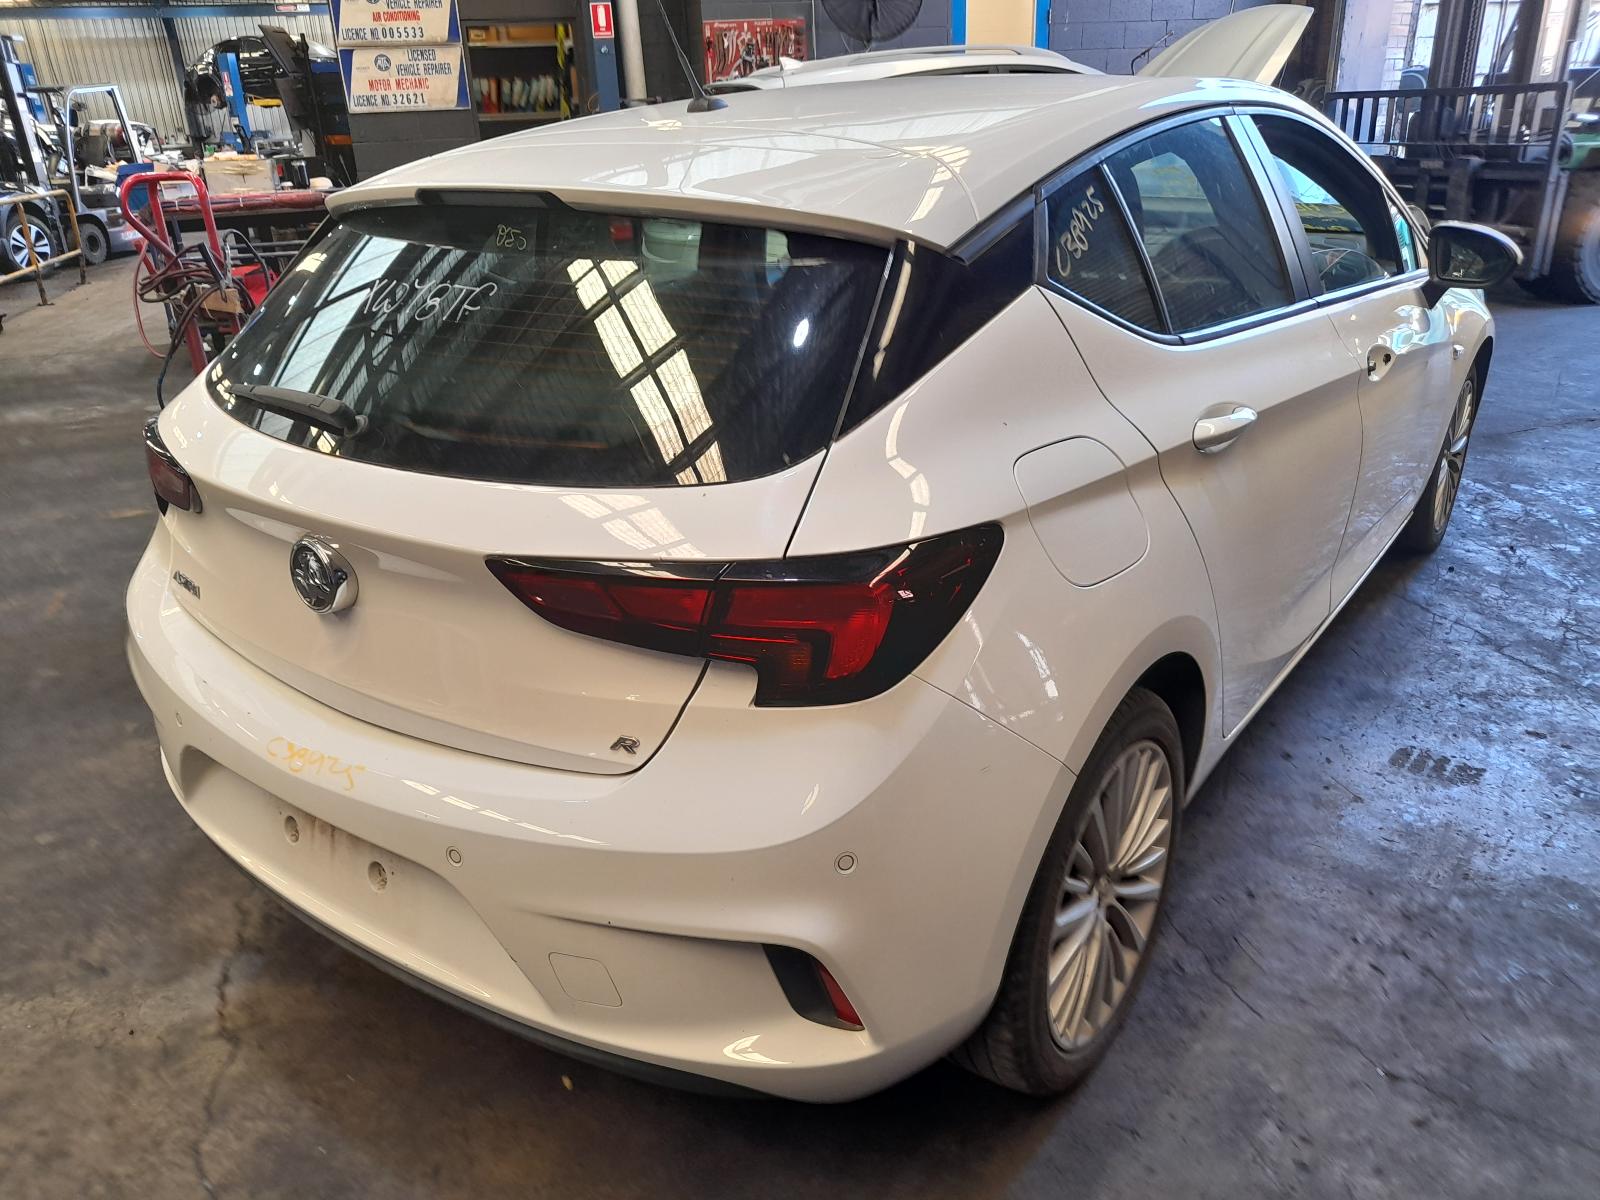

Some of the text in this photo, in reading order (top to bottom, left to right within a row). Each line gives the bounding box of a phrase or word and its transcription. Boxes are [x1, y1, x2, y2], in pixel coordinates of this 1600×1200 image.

[372, 10, 420, 22] AIR CONDITIONING
[341, 28, 367, 40] LICENCE
[381, 27, 424, 39] 005533
[407, 49, 436, 61] LICENSED
[396, 63, 452, 76] VEHICLE REPAIRER
[368, 78, 429, 91] MOTOR MECHANIC
[353, 94, 378, 107] LICENCE
[393, 93, 425, 105] 32621
[610, 735, 640, 754] R
